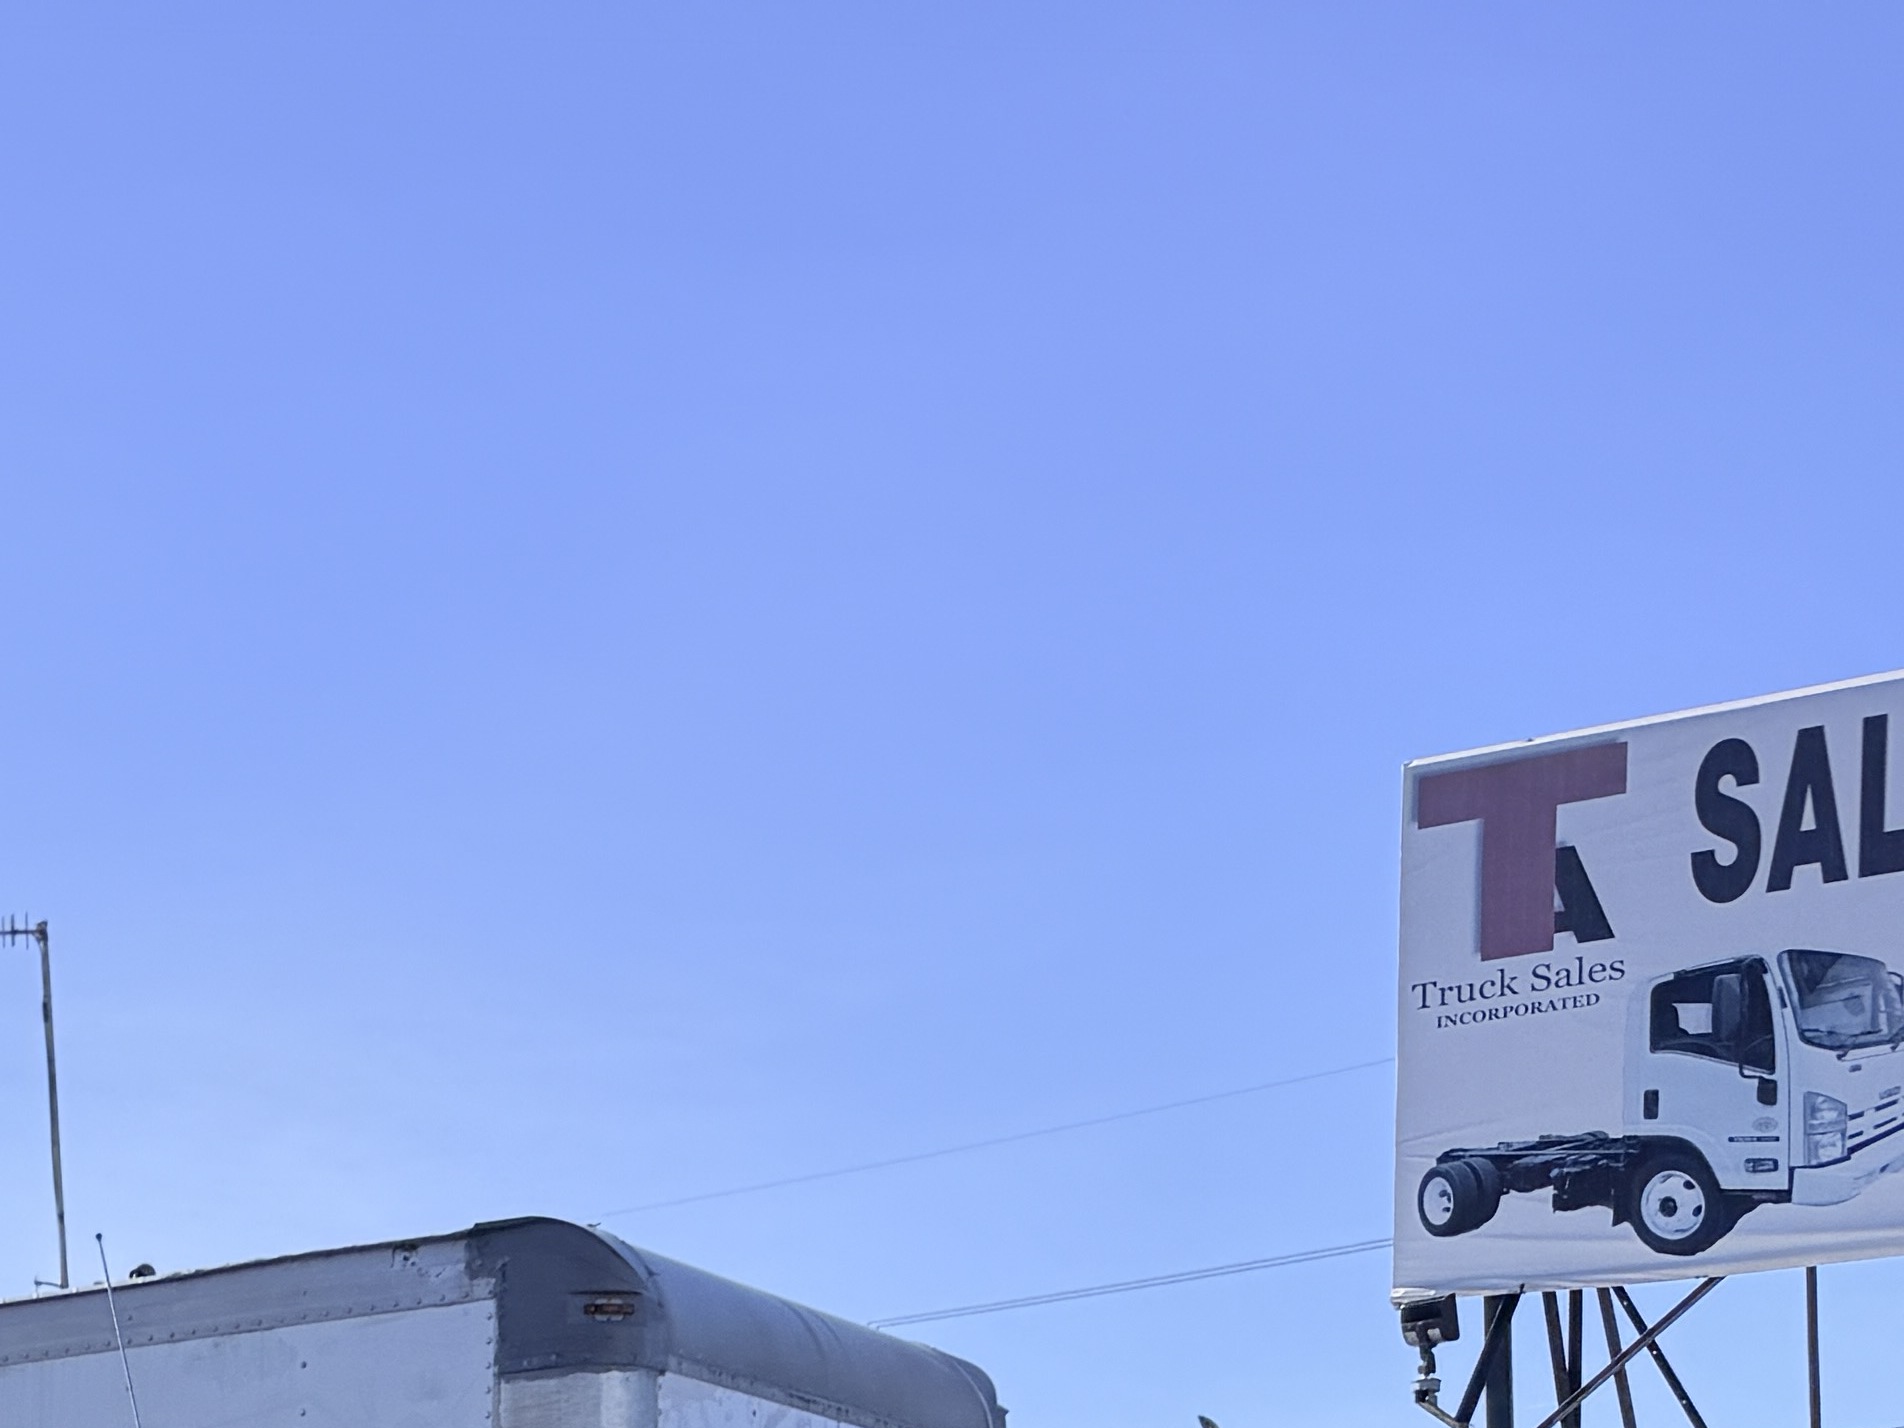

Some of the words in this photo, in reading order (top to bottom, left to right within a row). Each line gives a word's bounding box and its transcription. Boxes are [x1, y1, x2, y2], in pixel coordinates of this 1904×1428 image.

[1691, 714, 1904, 903] SAL
[1412, 969, 1518, 1010] Truck
[1530, 957, 1626, 992] Sales
[1437, 993, 1600, 1028] INCORPORATED
